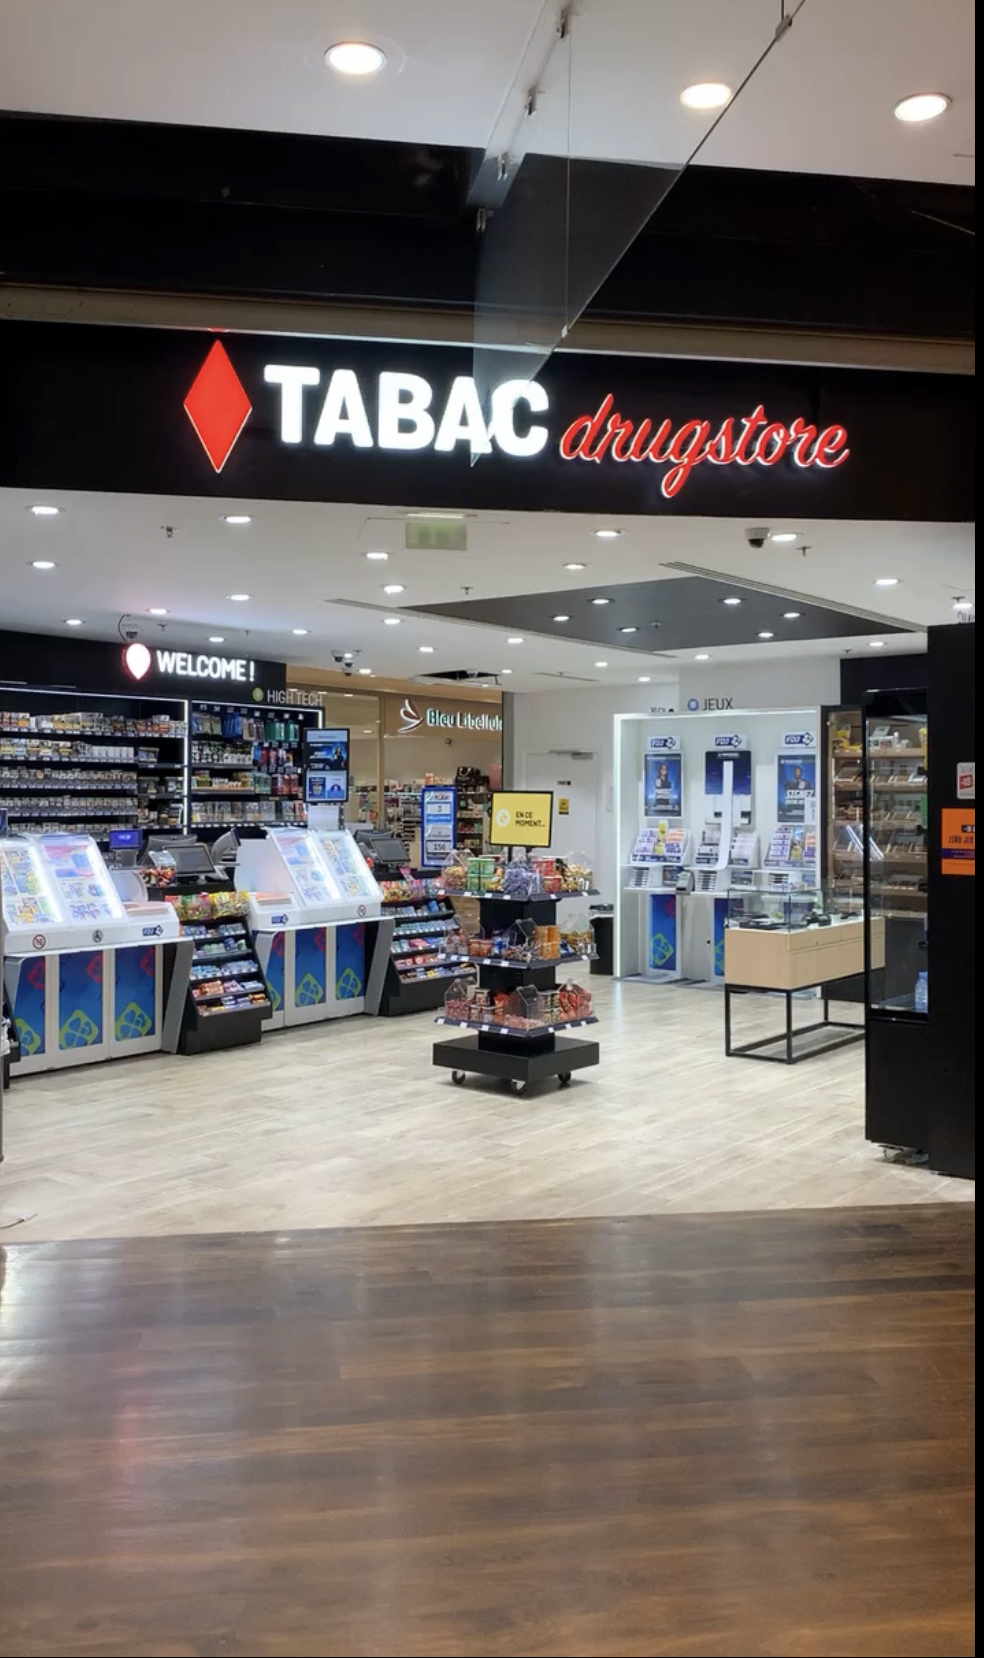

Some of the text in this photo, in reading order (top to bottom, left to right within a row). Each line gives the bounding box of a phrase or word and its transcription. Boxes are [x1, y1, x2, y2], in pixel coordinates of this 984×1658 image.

[263, 364, 850, 499] TABAC drugstore
[157, 650, 255, 682] WELCOME !
[266, 689, 323, 706] HIGH TECH
[702, 698, 733, 711] JEUX
[426, 708, 455, 727] Bleu
